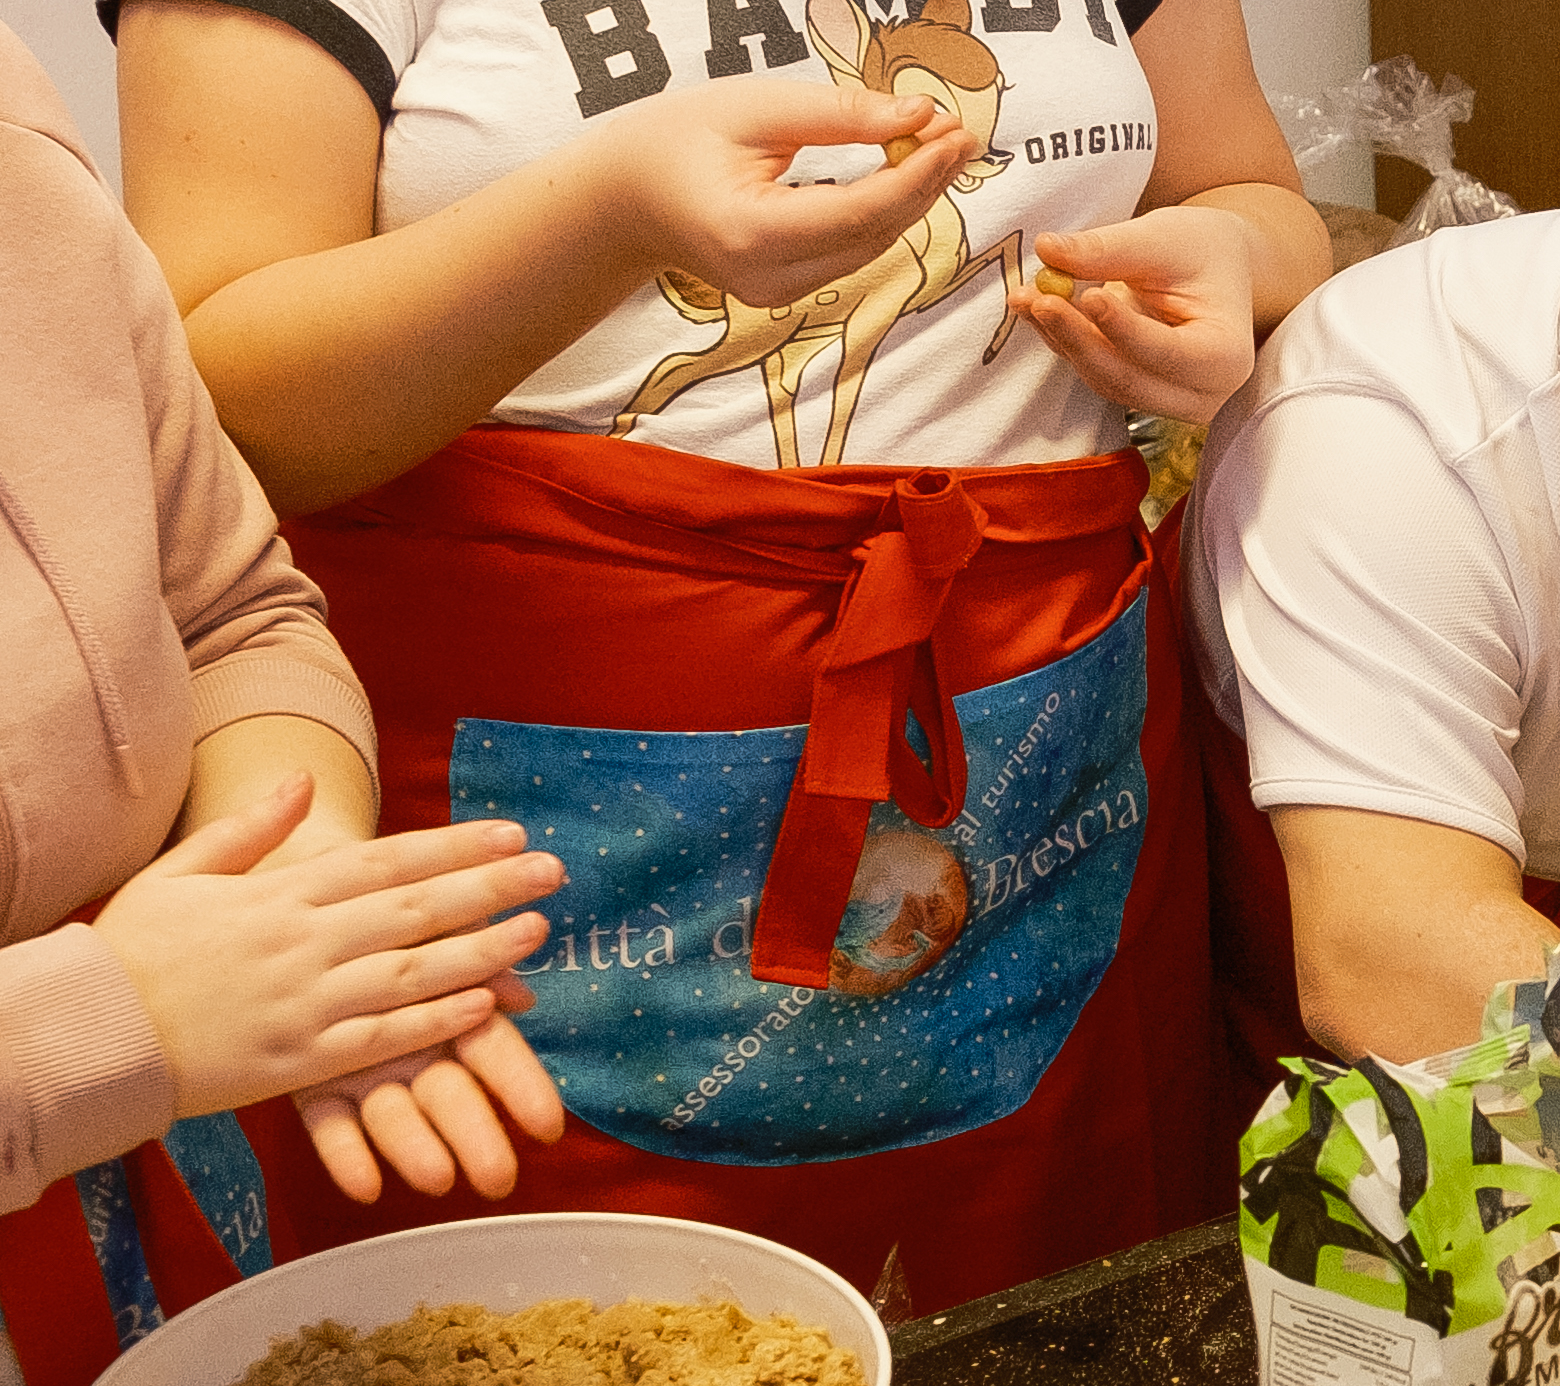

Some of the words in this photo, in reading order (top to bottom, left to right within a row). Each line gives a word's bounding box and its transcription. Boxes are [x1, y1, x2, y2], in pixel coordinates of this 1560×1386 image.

[1024, 122, 1153, 165] ORIGINAL
[661, 985, 816, 1132] assessorato
[981, 690, 1062, 811] turismo
[711, 895, 754, 959] d
[974, 789, 1140, 922] Brescia
